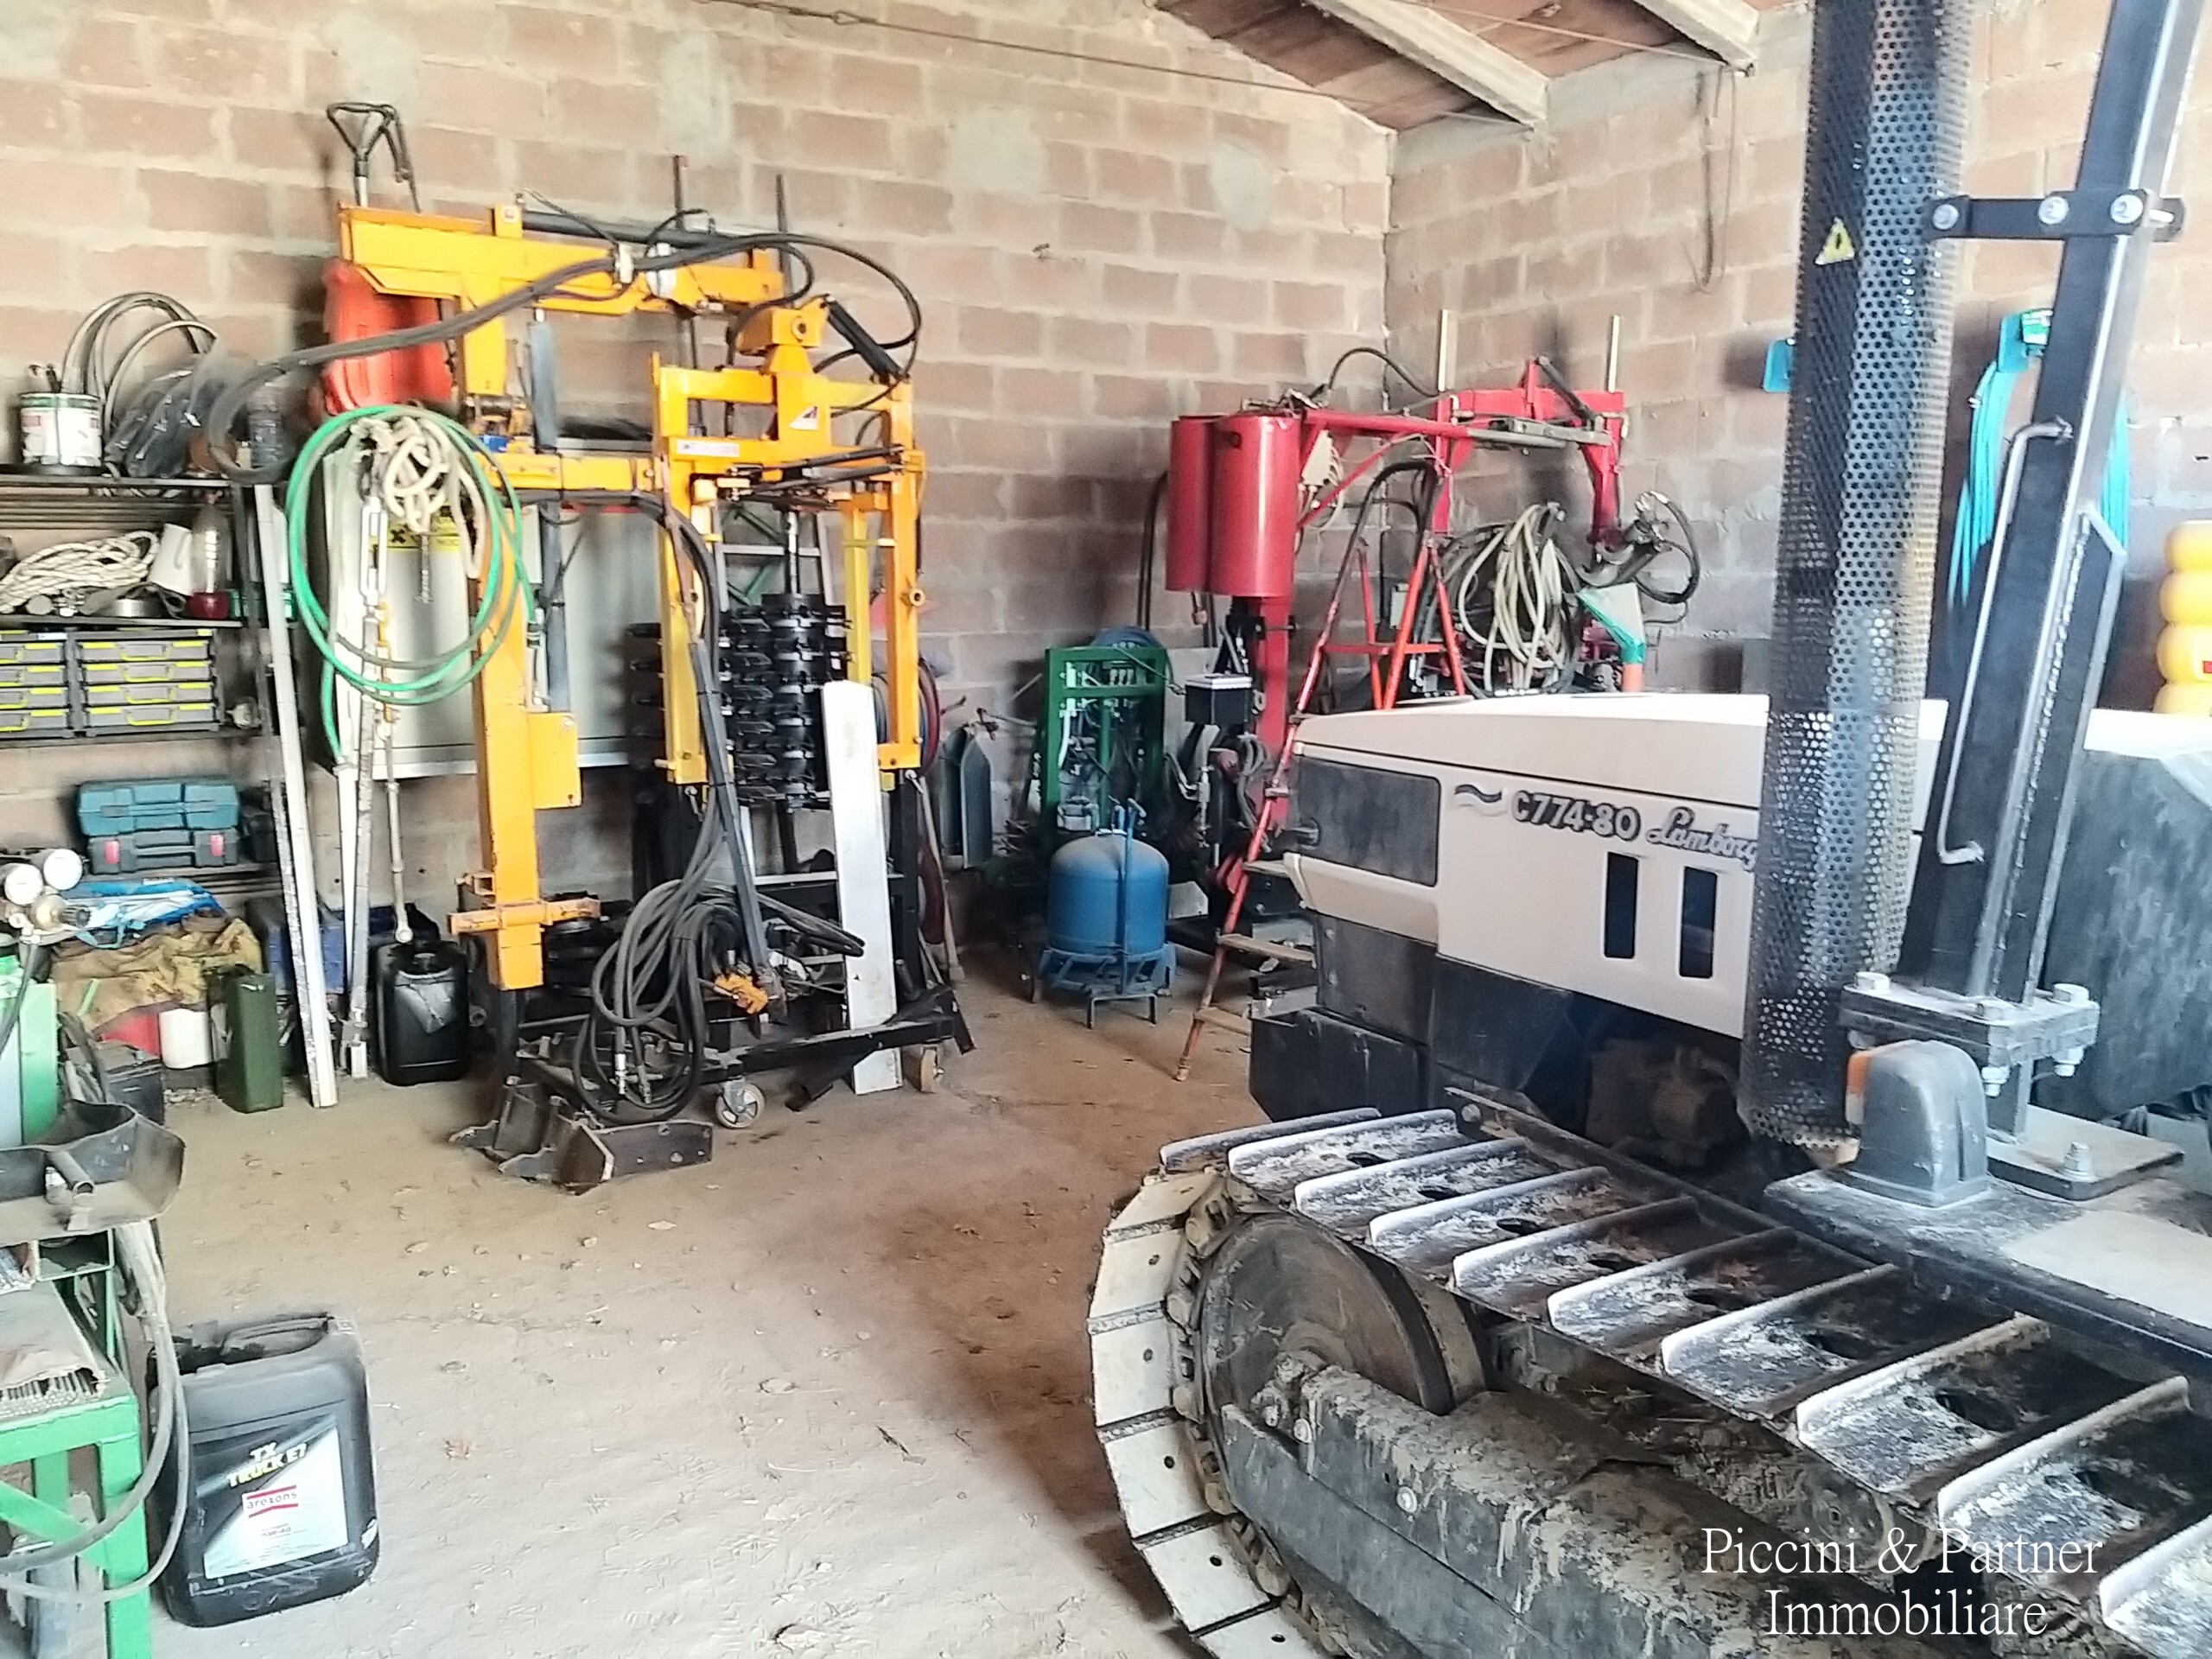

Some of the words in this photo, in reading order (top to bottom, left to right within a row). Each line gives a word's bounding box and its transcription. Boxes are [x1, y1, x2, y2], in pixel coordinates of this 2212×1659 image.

[1513, 790, 1642, 842] C774-80
[1646, 806, 1758, 873] Lamborg
[250, 1441, 277, 1462] TX
[226, 1452, 285, 1488] TRUCK
[247, 1491, 297, 1510] arexons
